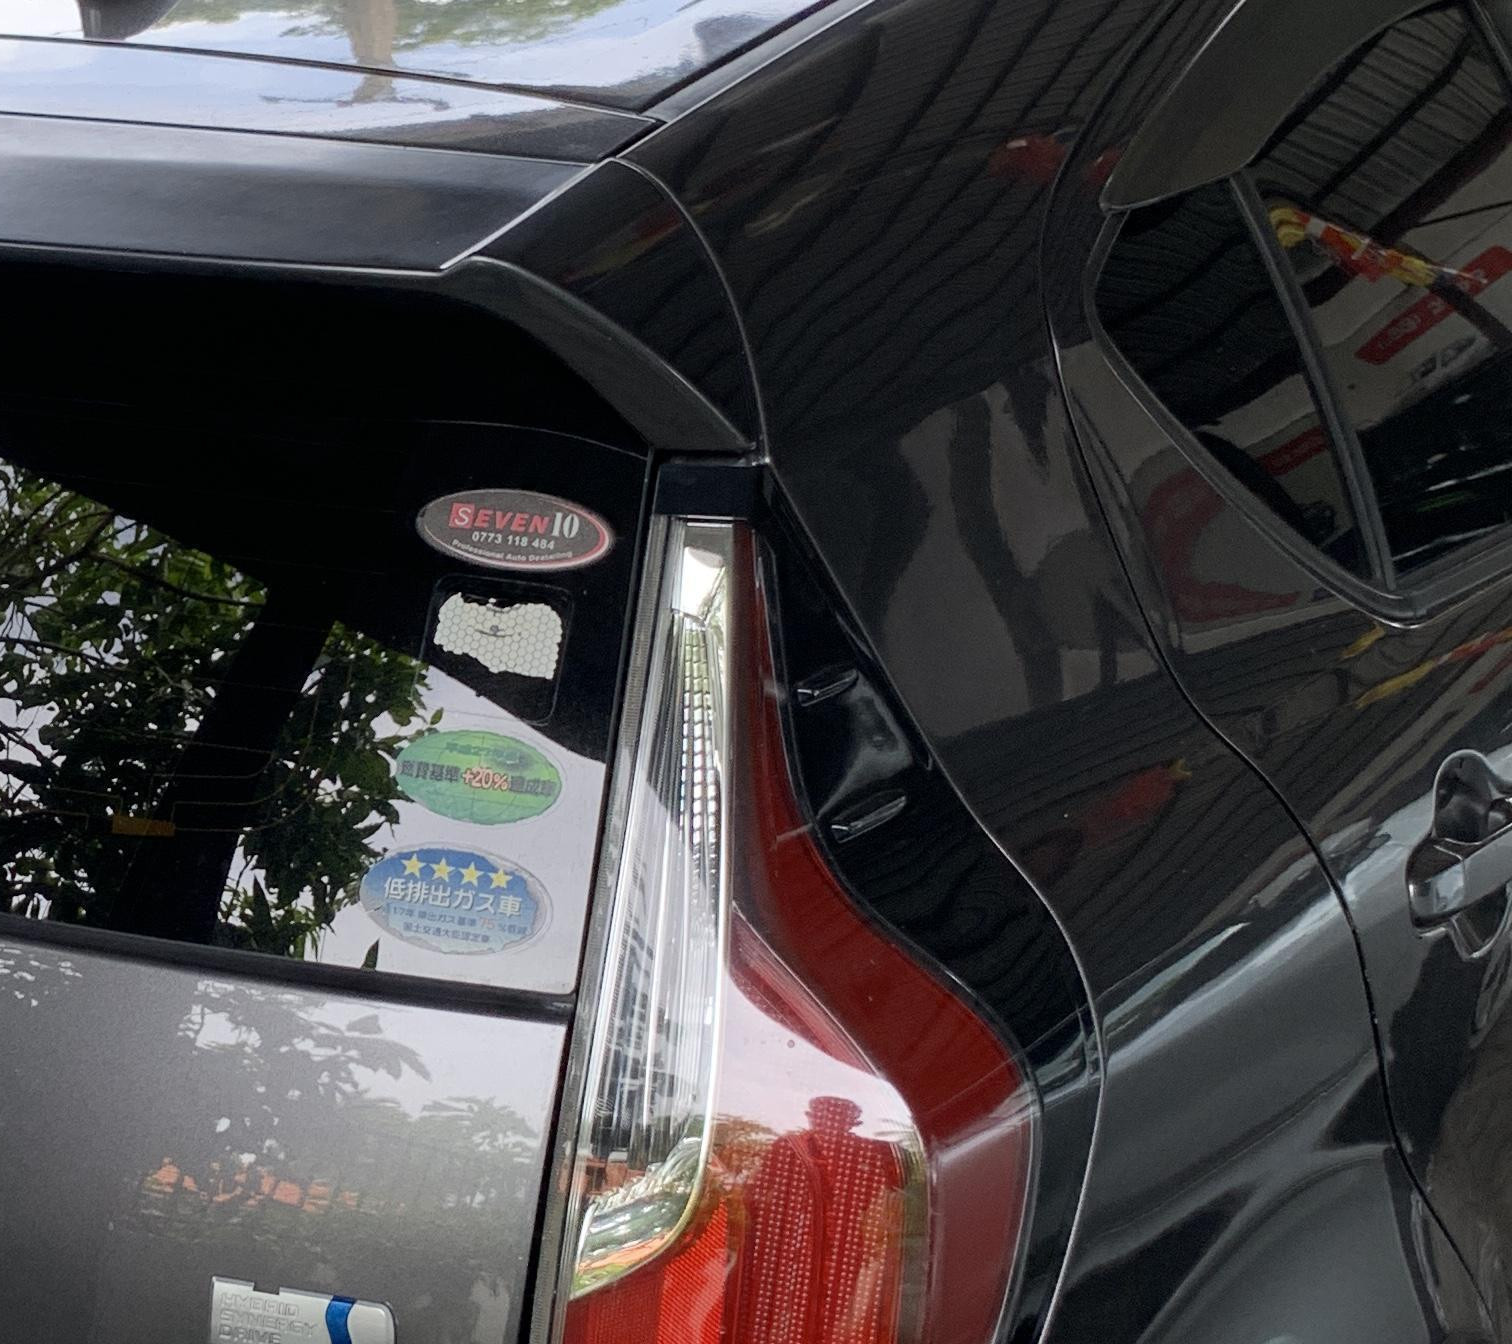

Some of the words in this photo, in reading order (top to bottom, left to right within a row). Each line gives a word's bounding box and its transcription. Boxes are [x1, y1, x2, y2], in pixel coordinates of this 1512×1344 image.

[451, 539, 504, 561] Professional
[505, 552, 528, 562] Auto
[471, 531, 502, 544] 0773
[507, 533, 528, 548] 118
[384, 876, 523, 918] 低排出ガス車
